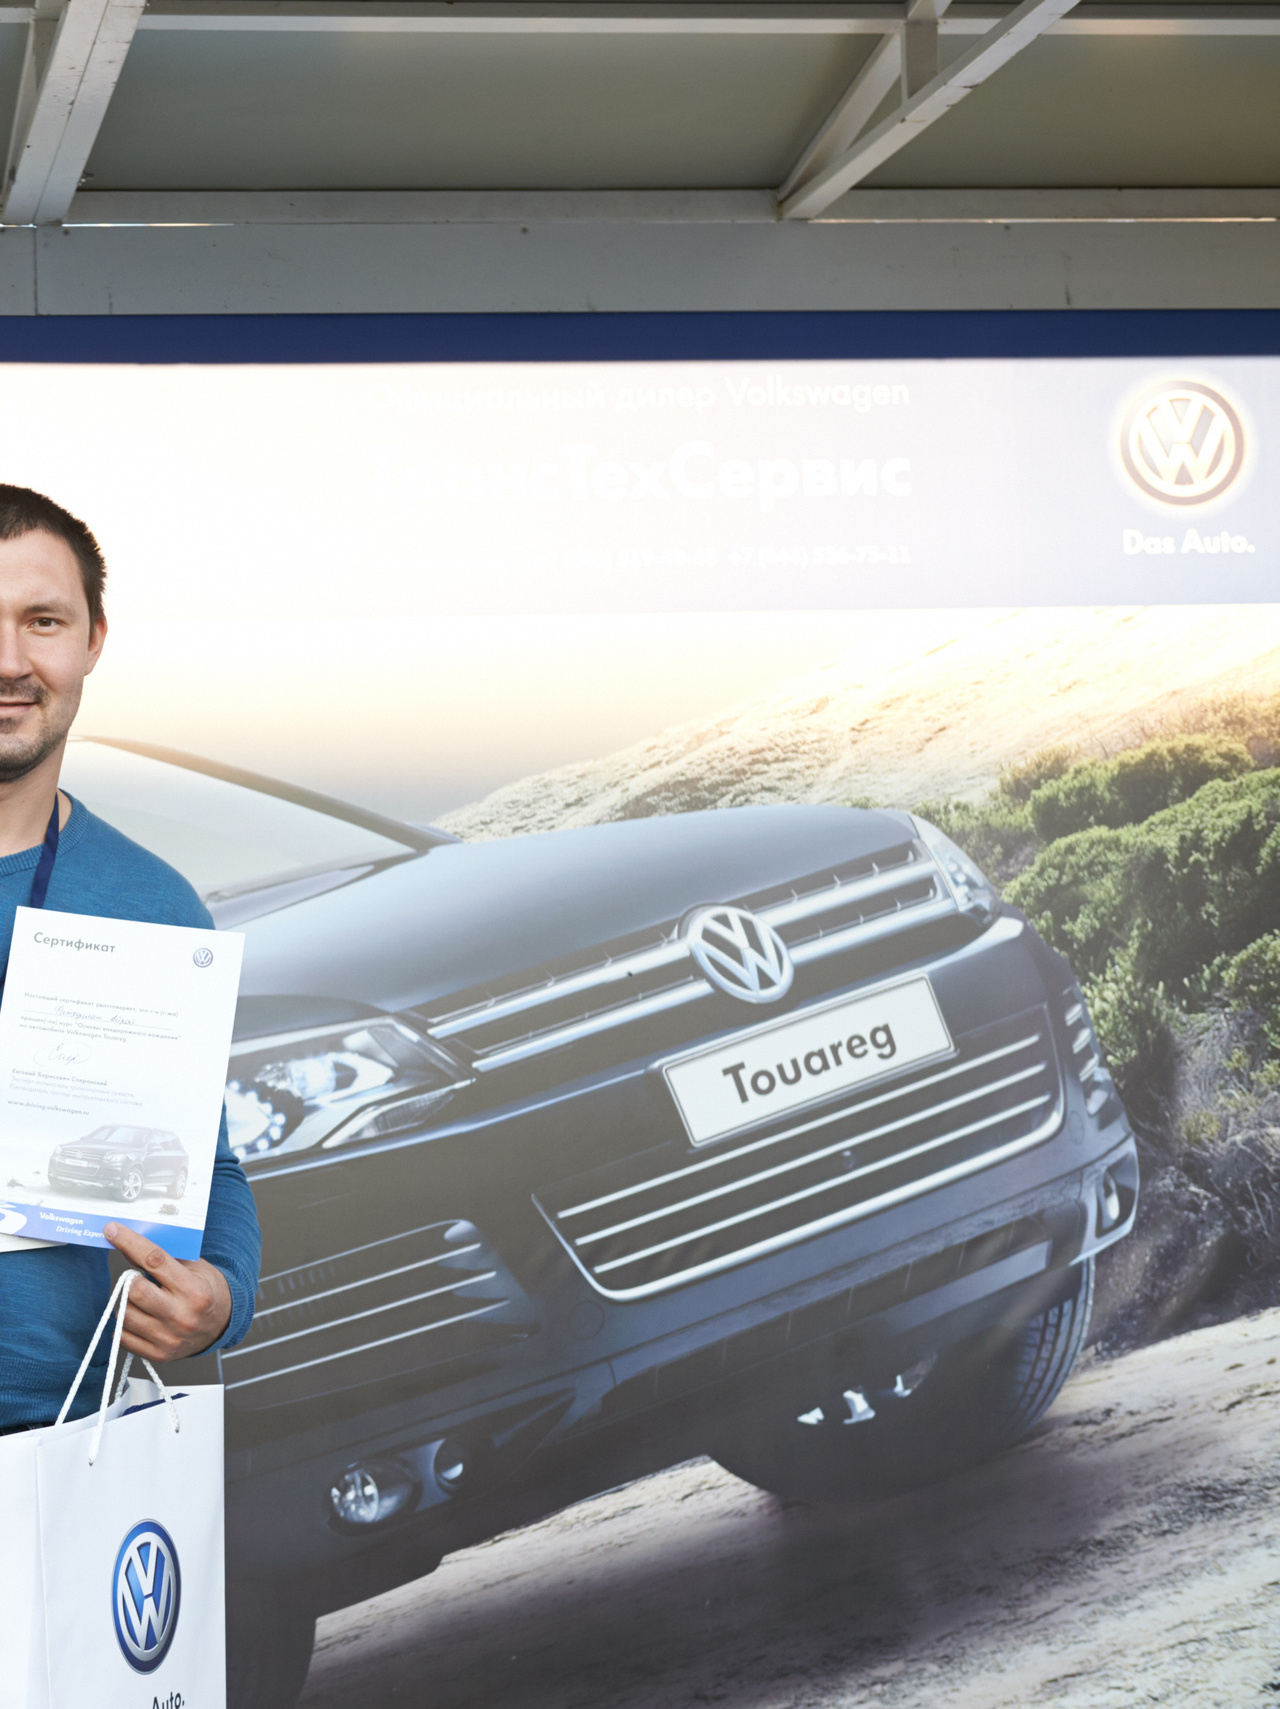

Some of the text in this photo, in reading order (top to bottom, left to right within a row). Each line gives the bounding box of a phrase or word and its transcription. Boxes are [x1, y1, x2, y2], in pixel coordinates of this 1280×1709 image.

[615, 387, 715, 414] дилер
[724, 376, 910, 412] Volkswagen
[1122, 528, 1256, 555] Das Auto.
[33, 932, 116, 953] Сертификат
[66, 1028, 102, 1039] Volkswagen
[104, 1034, 127, 1042] Touareg
[722, 1023, 897, 1104] Touareg
[40, 1212, 83, 1225] Volkswagen
[56, 1225, 82, 1237] Driving
